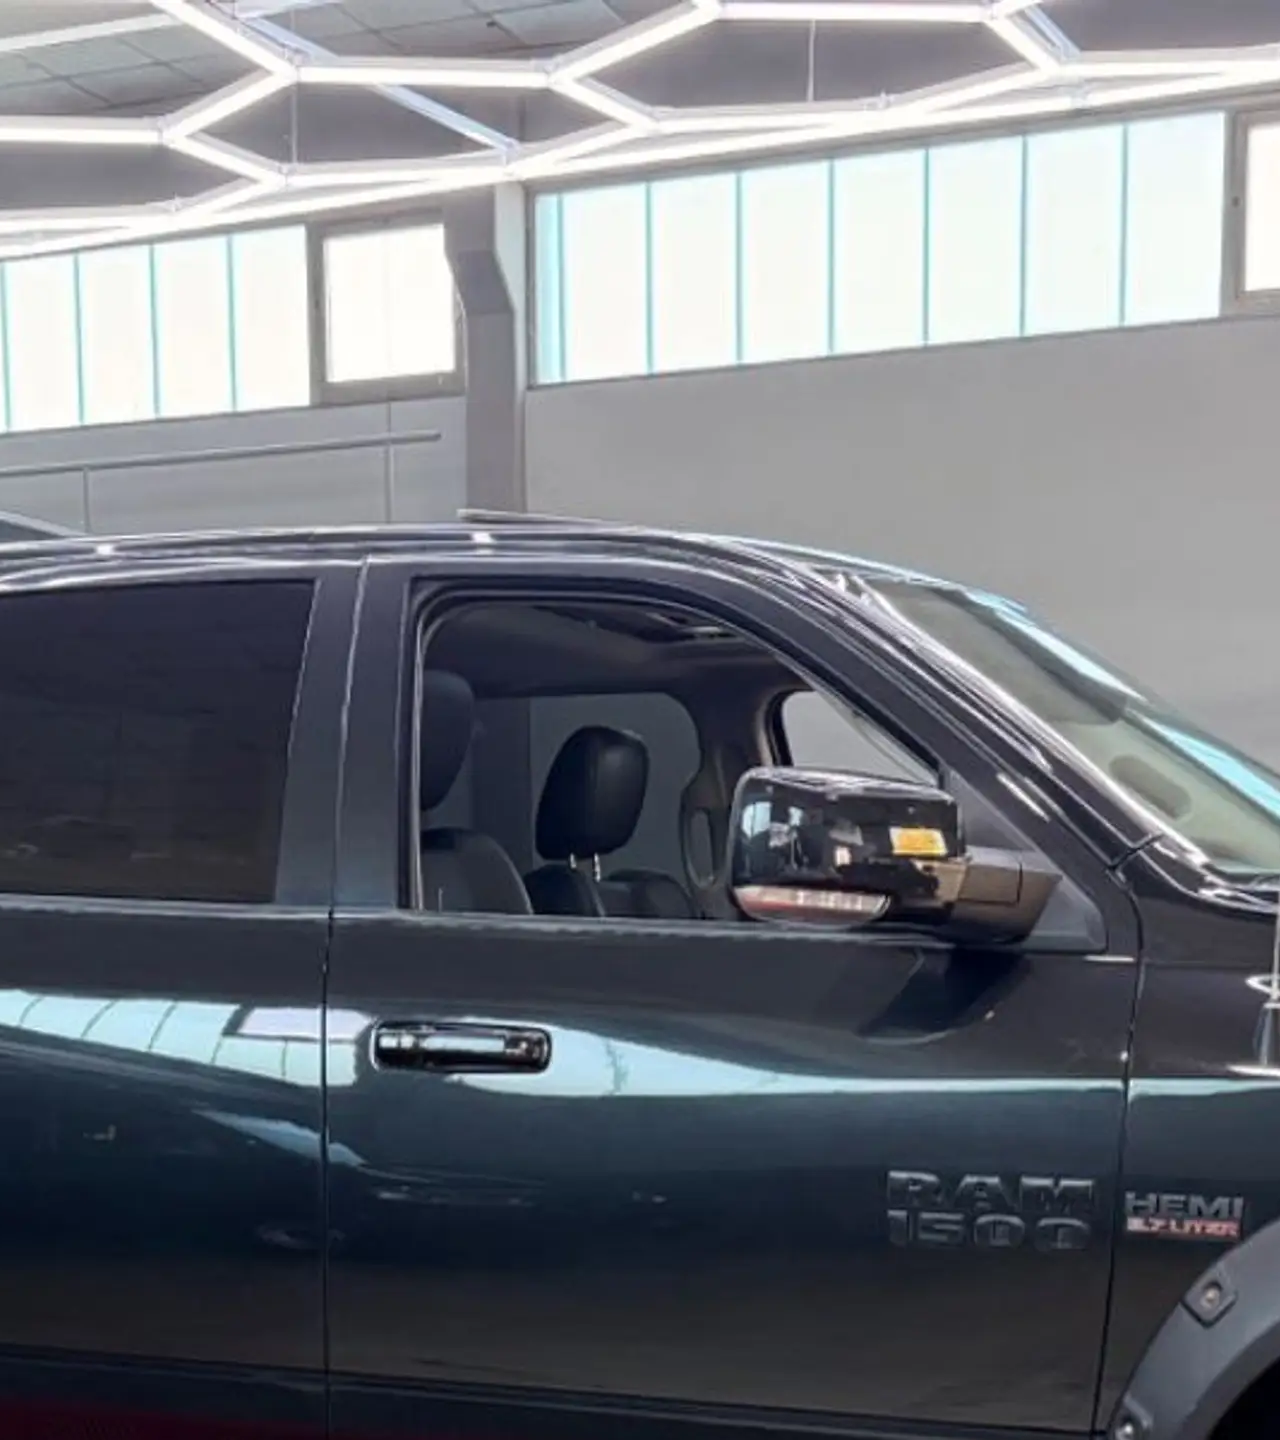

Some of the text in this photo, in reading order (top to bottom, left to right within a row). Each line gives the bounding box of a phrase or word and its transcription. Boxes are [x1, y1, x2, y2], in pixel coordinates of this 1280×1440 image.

[887, 1170, 1096, 1212] RAM
[1124, 1190, 1244, 1219] HEMI
[886, 1209, 1093, 1251] 1500
